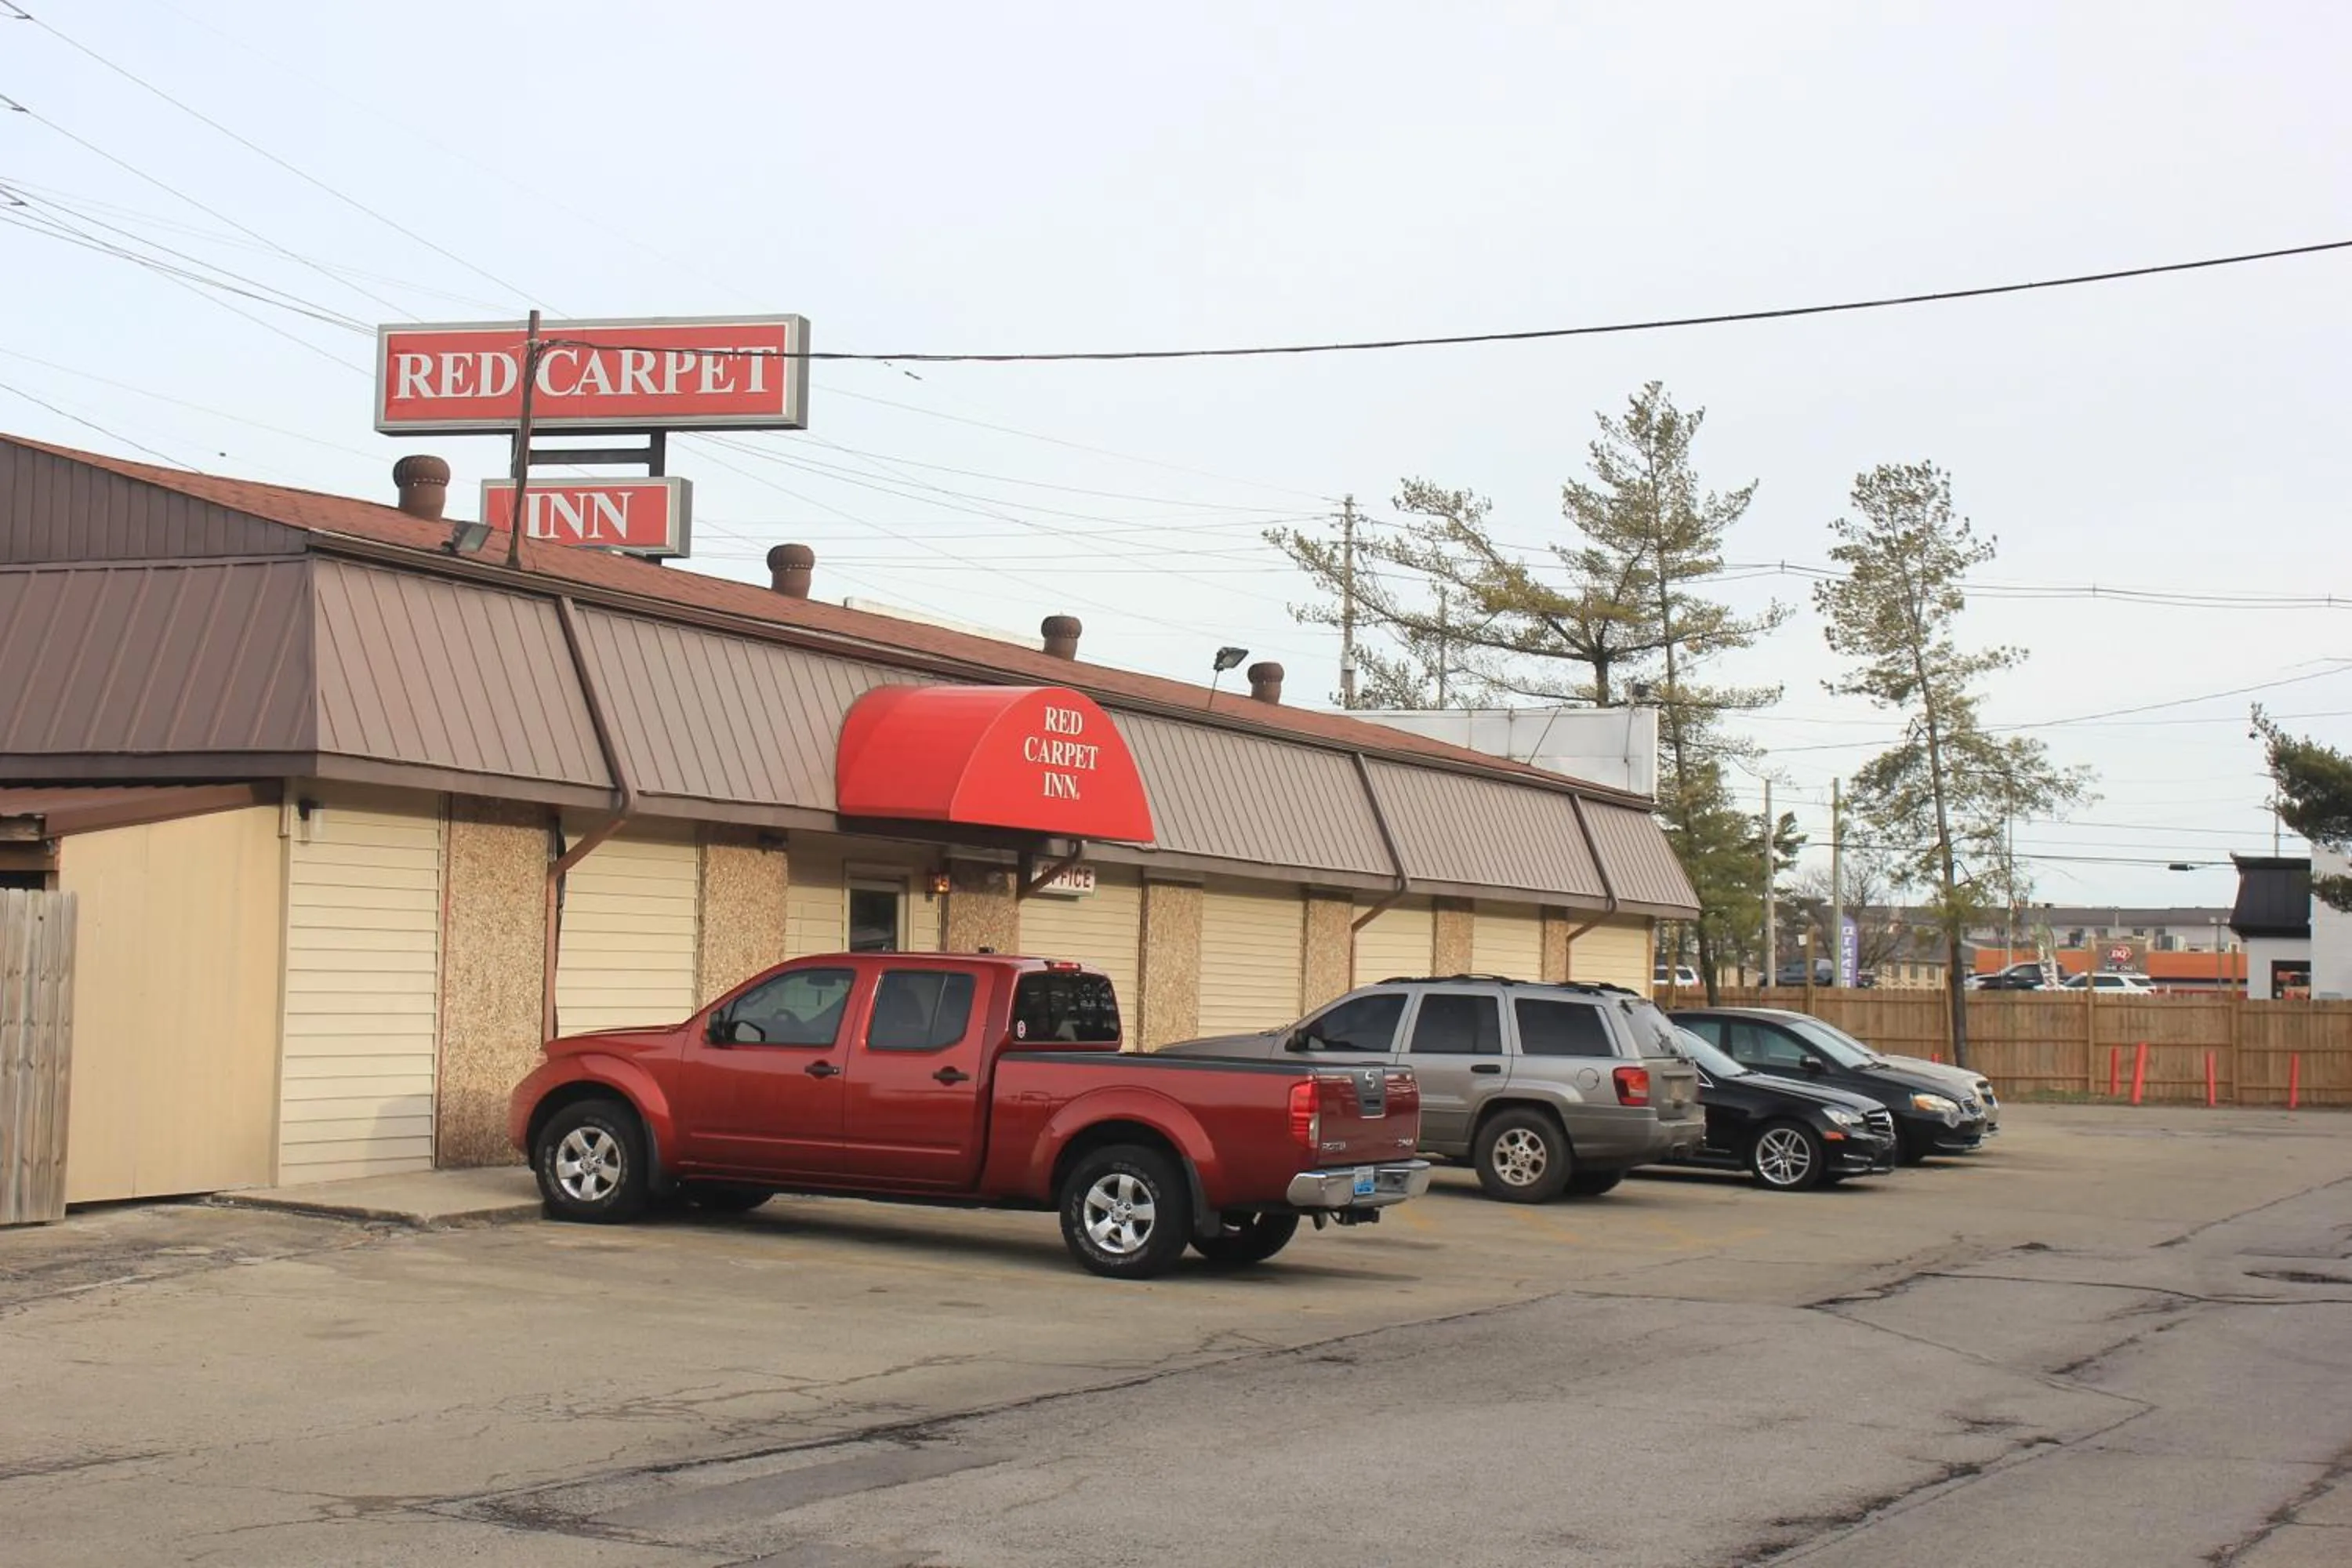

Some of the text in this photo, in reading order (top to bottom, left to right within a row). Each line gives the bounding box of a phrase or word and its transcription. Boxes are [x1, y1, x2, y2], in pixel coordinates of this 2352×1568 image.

[394, 346, 778, 398] RED CARPET
[526, 492, 633, 540] INN
[1044, 706, 1083, 735] RED
[1024, 736, 1098, 769] CARPET
[1042, 864, 1091, 888] FICE
